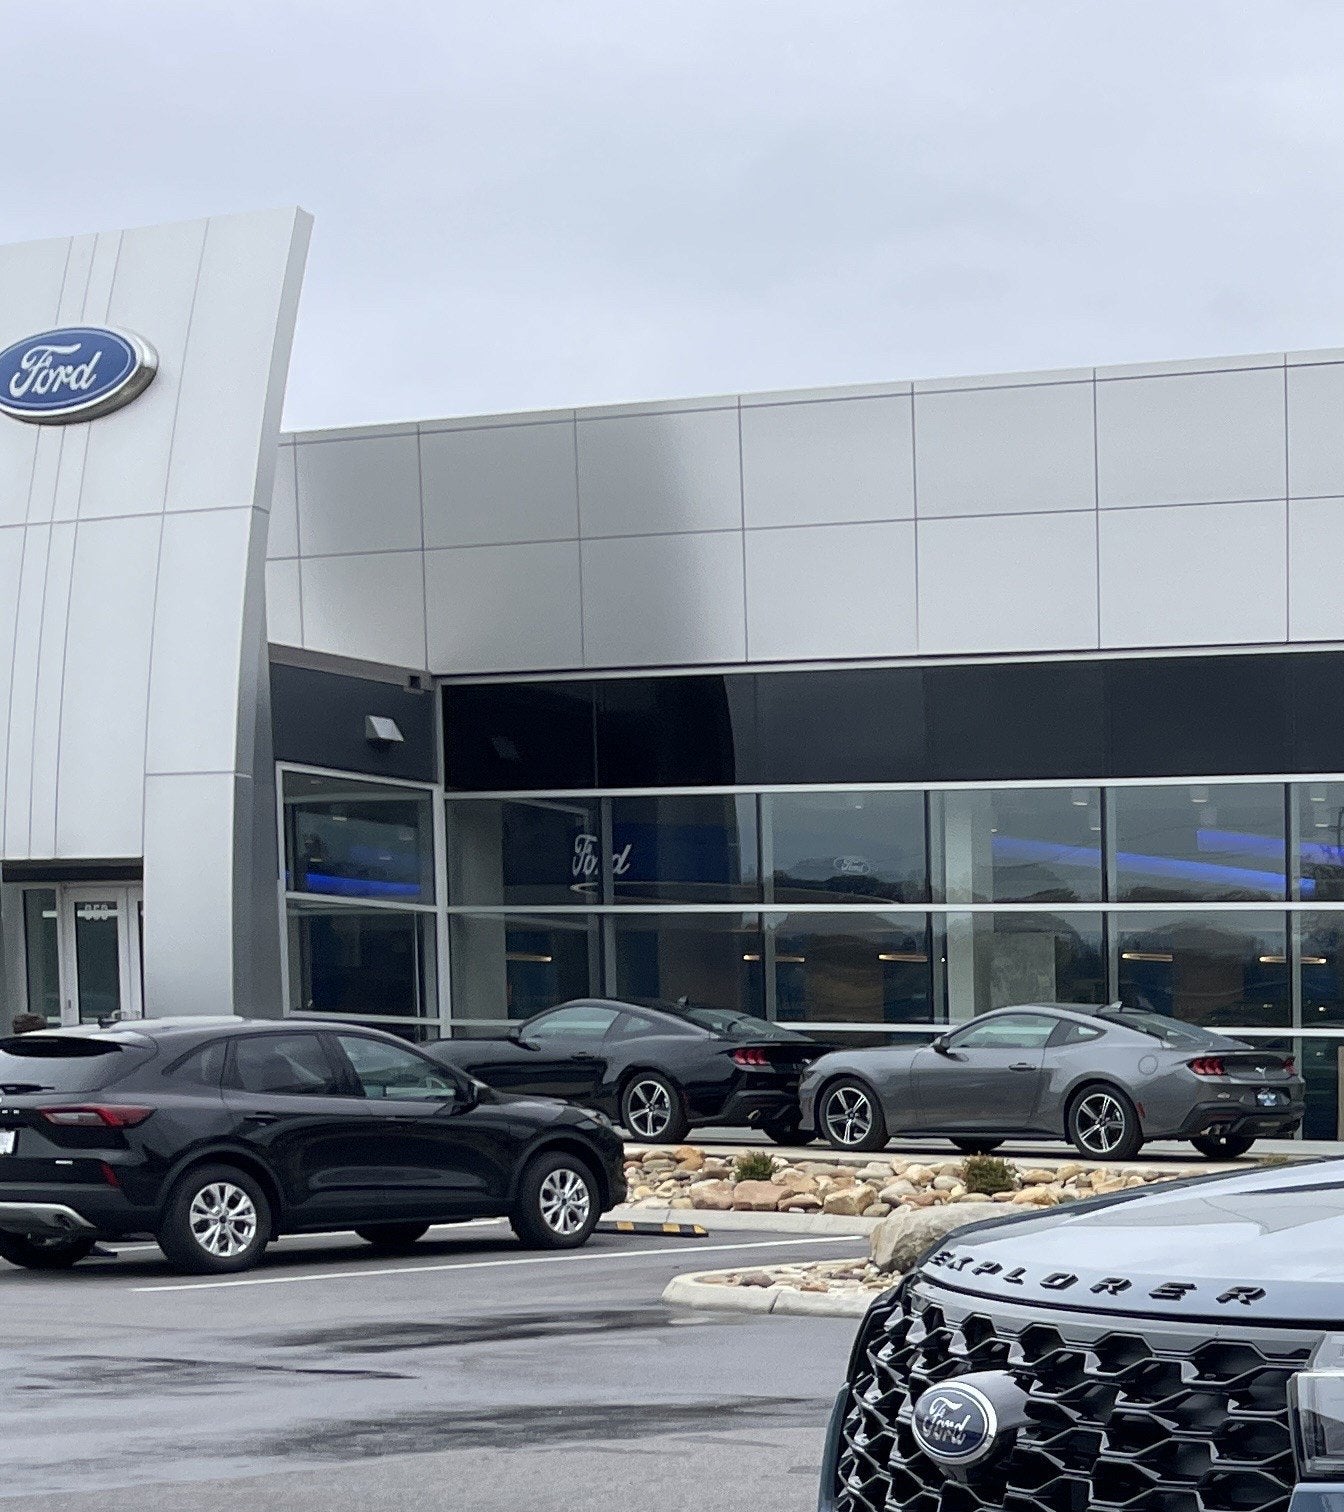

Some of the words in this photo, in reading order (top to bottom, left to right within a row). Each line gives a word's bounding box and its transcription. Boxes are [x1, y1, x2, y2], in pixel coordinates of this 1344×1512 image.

[9, 343, 102, 398] Ford
[571, 834, 632, 876] Fod
[926, 1250, 1267, 1306] EXPLORER
[922, 1396, 971, 1446] Ford
